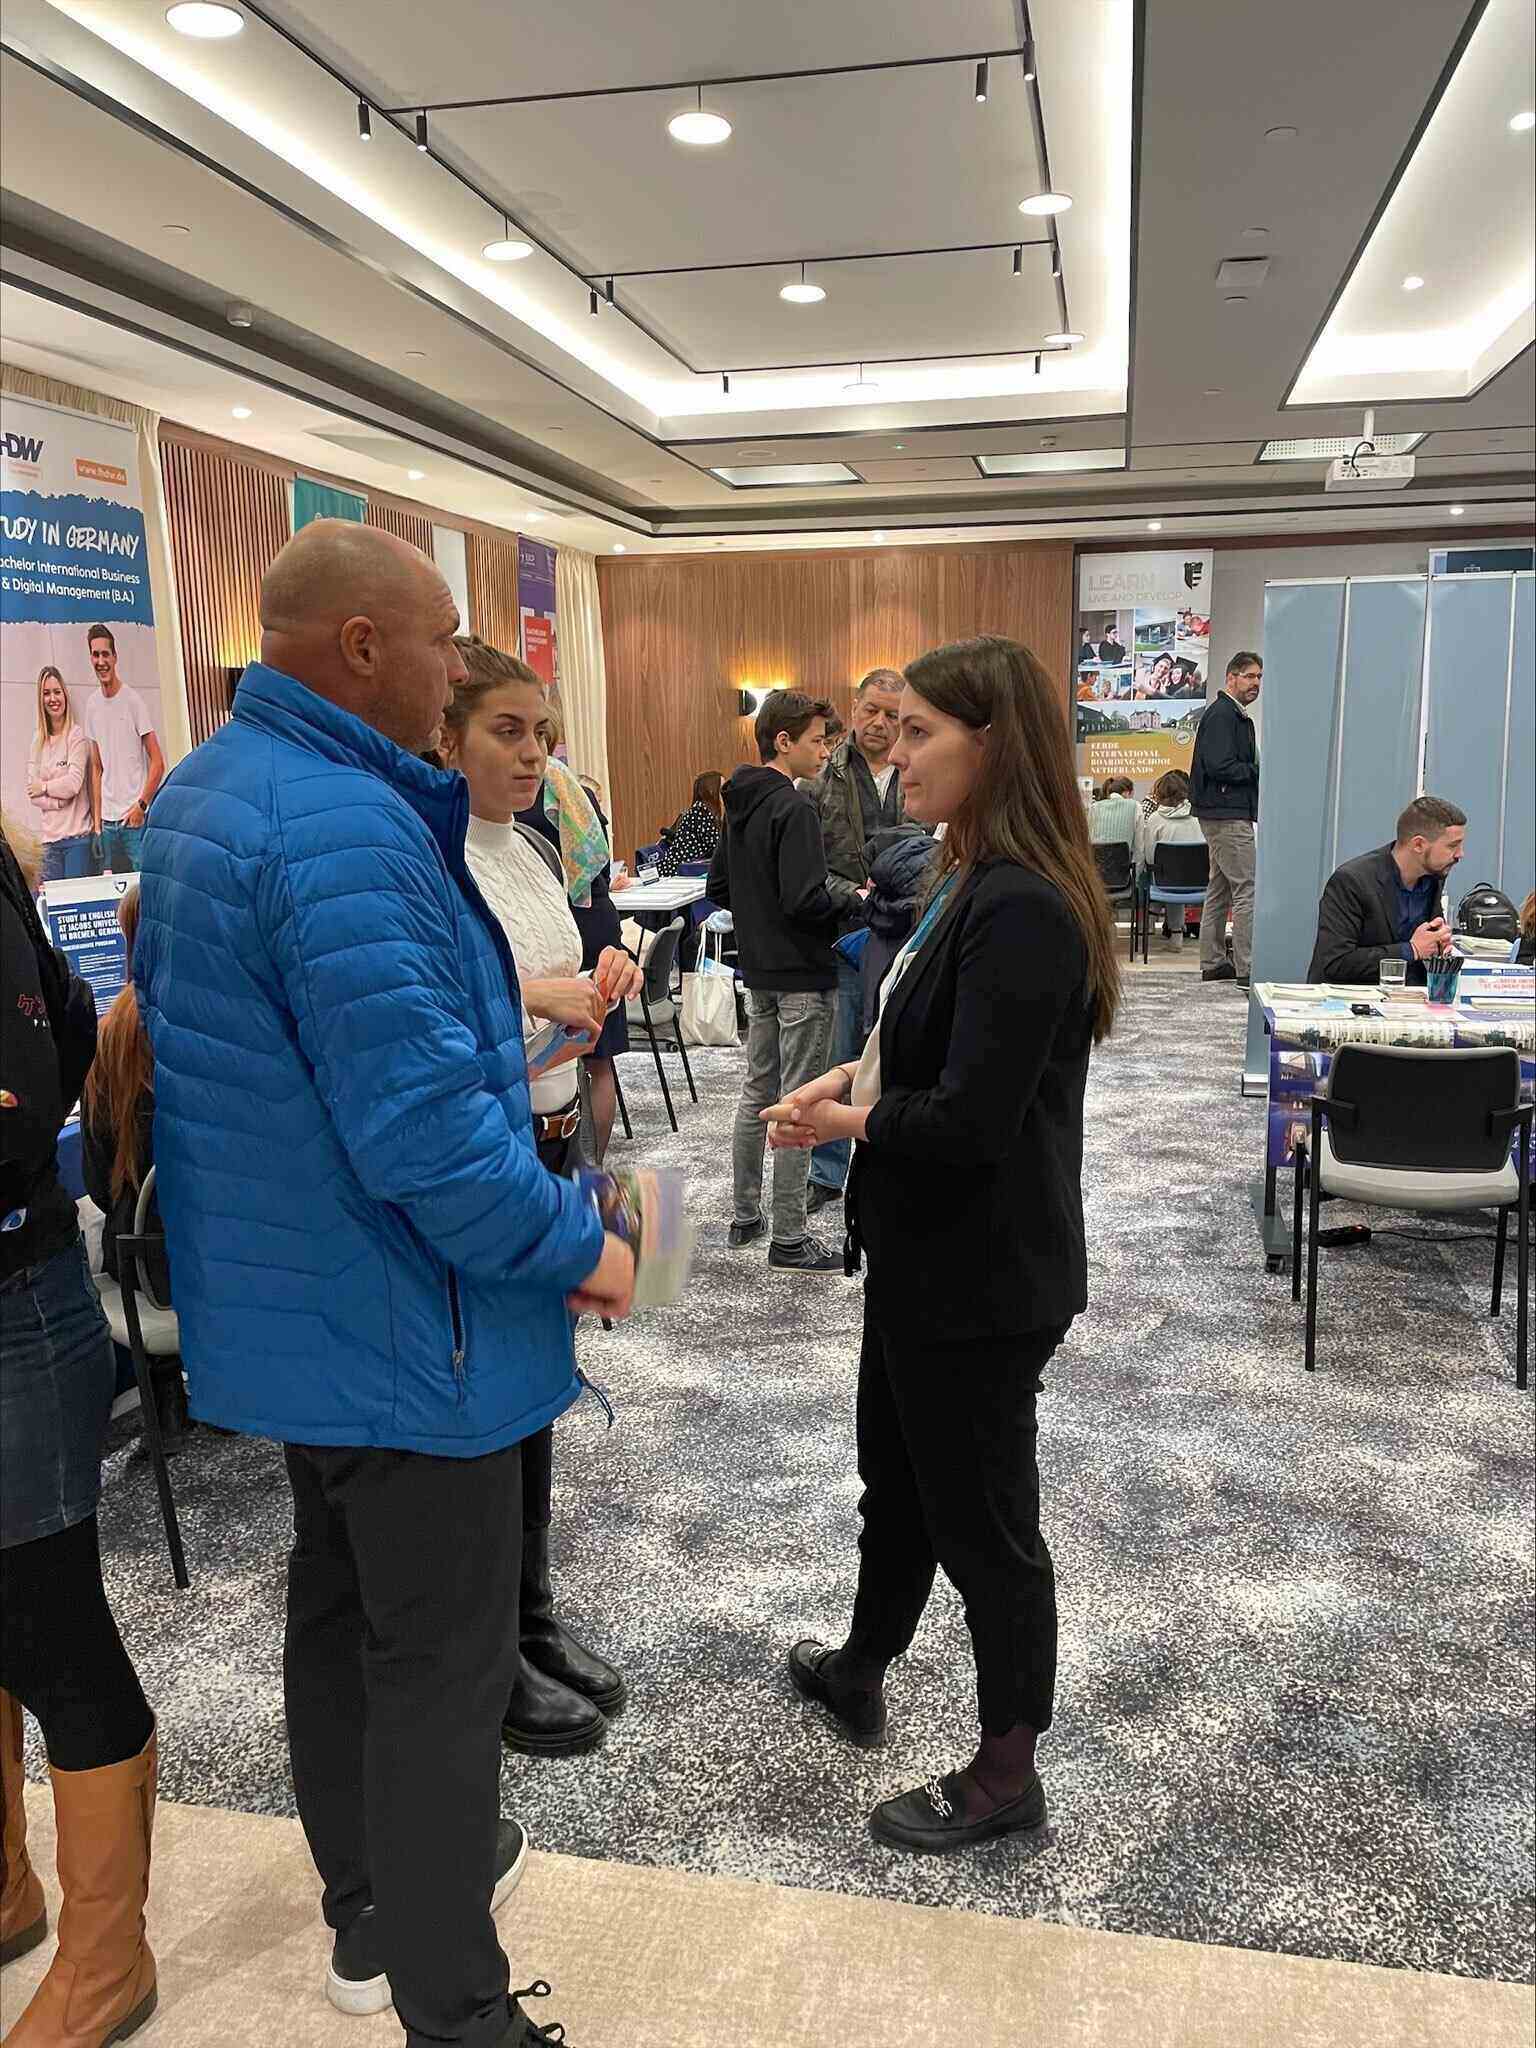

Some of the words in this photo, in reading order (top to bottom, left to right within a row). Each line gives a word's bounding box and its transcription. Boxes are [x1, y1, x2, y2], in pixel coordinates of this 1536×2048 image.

[42, 520, 60, 546] IN
[66, 525, 139, 559] GERMANY
[37, 560, 100, 578] International
[101, 568, 140, 584] Business
[1, 576, 10, 590] &
[12, 578, 44, 595] Digital
[46, 582, 109, 600] Management
[1089, 572, 1154, 591] LEARN
[1090, 750, 1159, 758] INTERNATIONAL
[1090, 758, 1135, 766] BOARDING
[1136, 757, 1171, 765] SCHOOL
[1090, 766, 1154, 774] NETHERLANDS
[58, 914, 78, 924] STUDY
[80, 912, 87, 921] IN
[88, 910, 116, 921] ENGLISH
